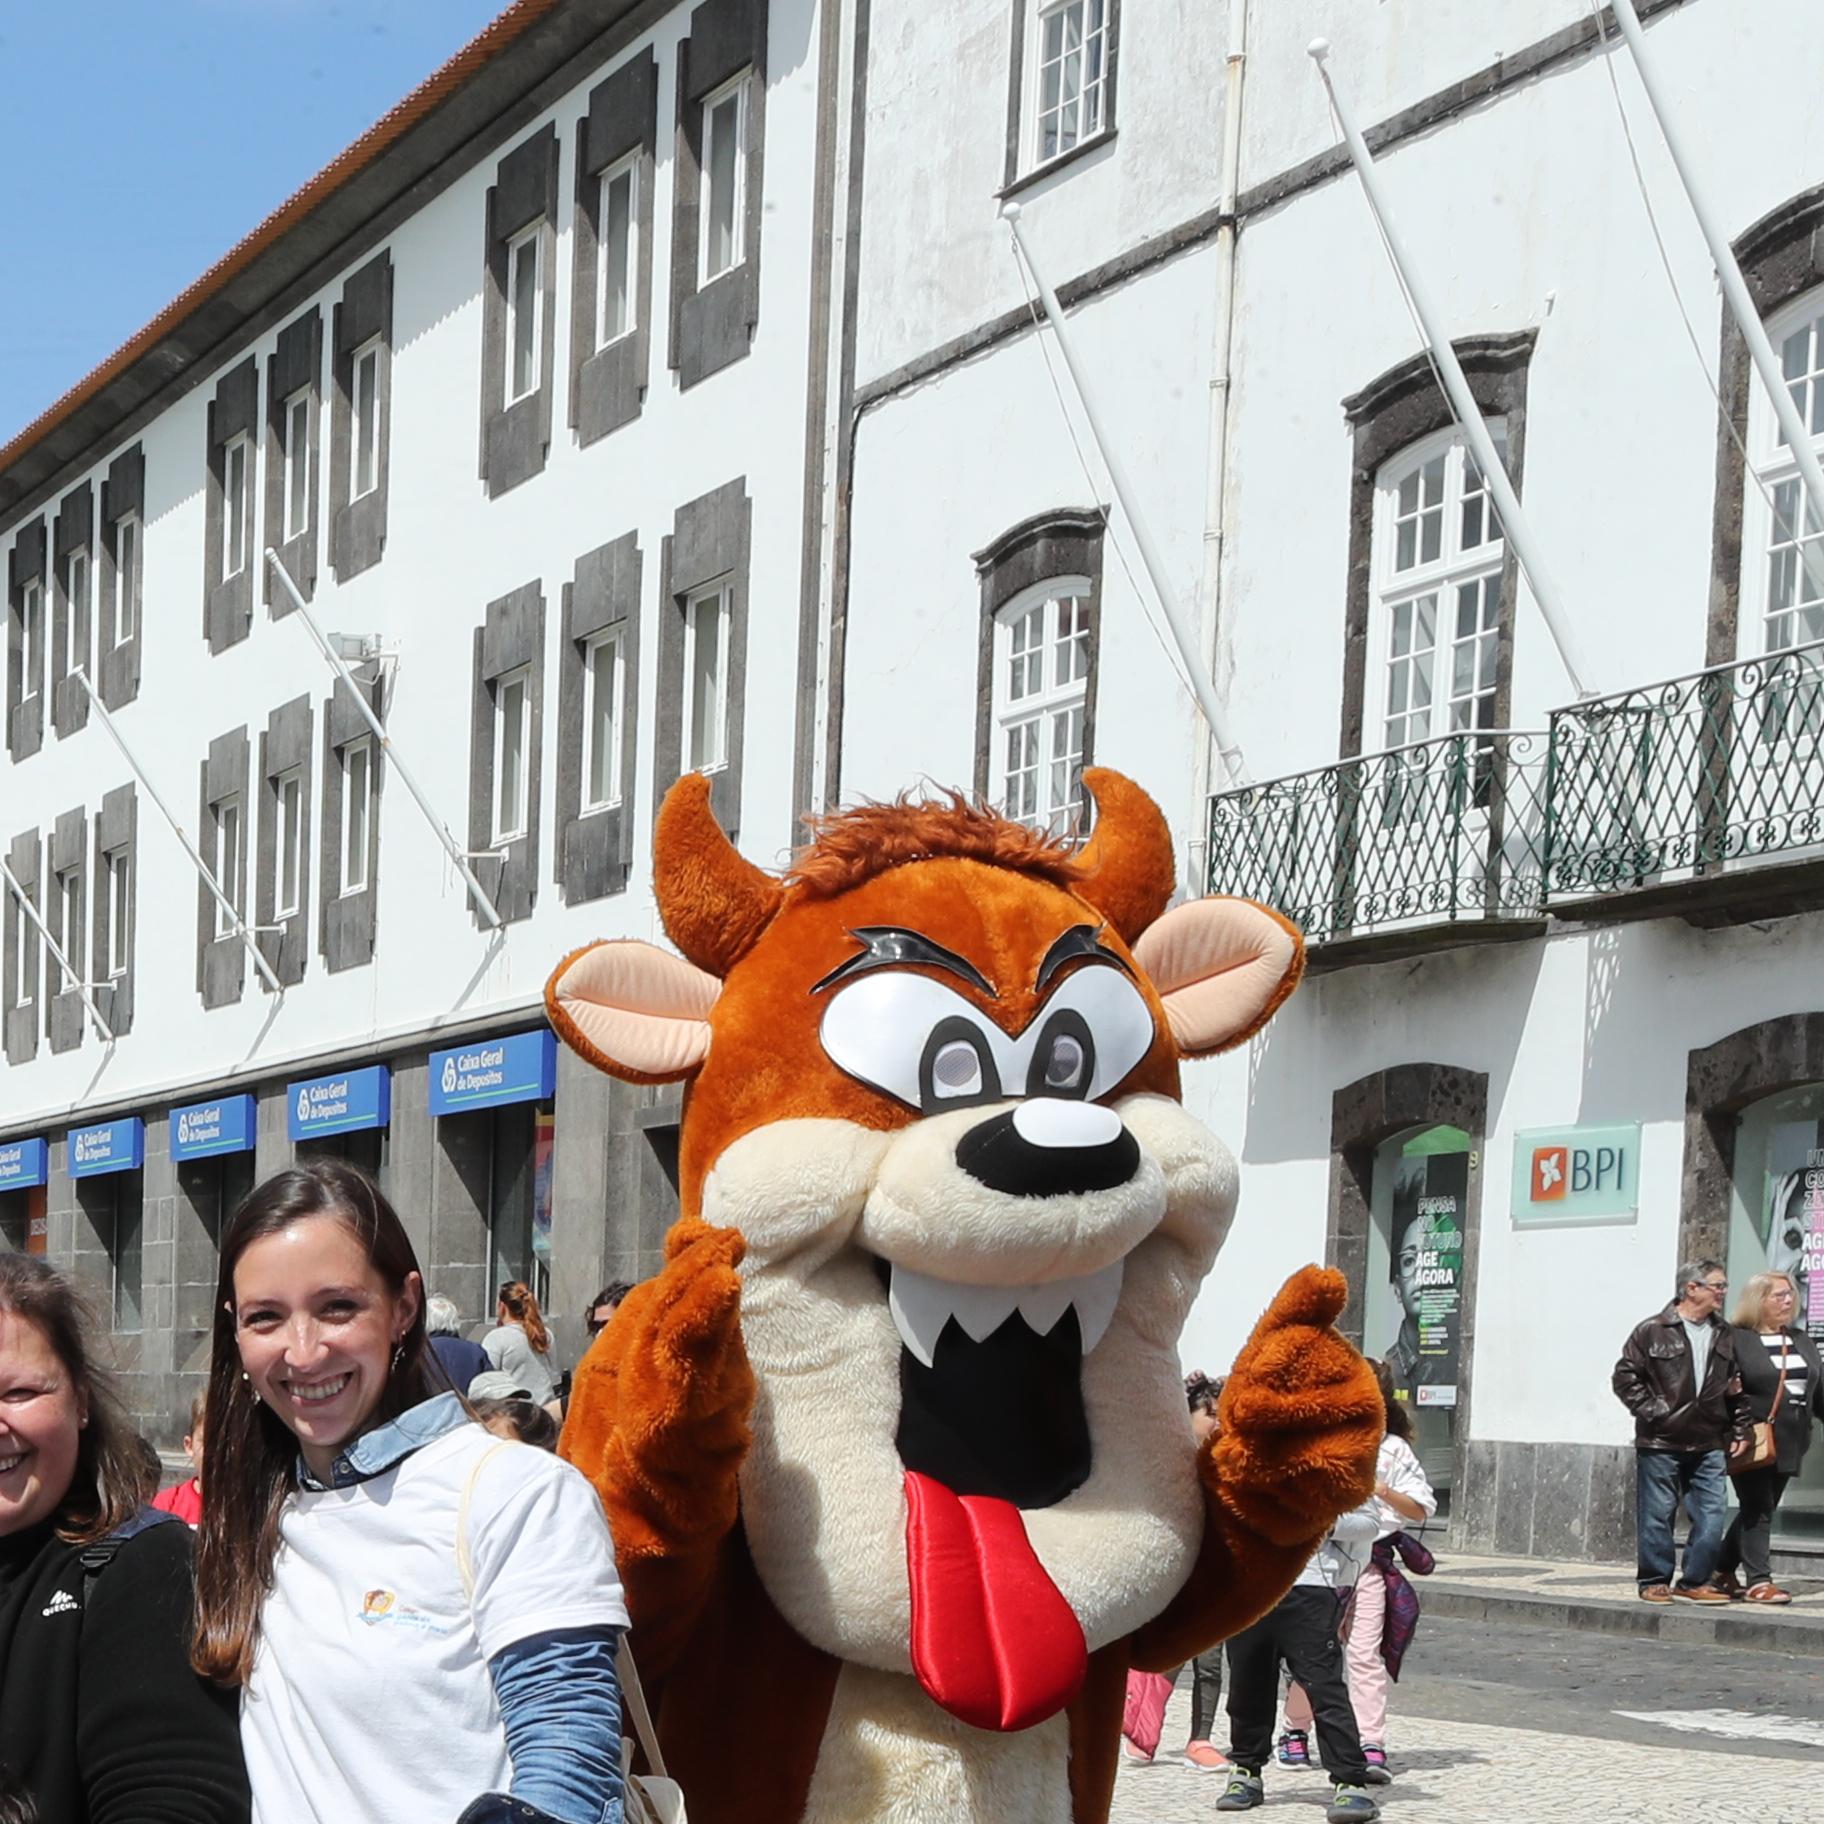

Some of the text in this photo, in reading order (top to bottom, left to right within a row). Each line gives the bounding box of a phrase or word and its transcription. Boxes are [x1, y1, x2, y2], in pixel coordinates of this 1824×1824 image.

[457, 1047, 503, 1072] Caixa Geral
[310, 1080, 348, 1101] Caixa Geral
[457, 1075, 466, 1091] de
[188, 1108, 220, 1127] Caixa Geral
[1469, 1151, 1478, 1169] 9
[1571, 1147, 1624, 1192] BPI
[1415, 1251, 1439, 1267] AGE
[1414, 1268, 1454, 1285] AGORA
